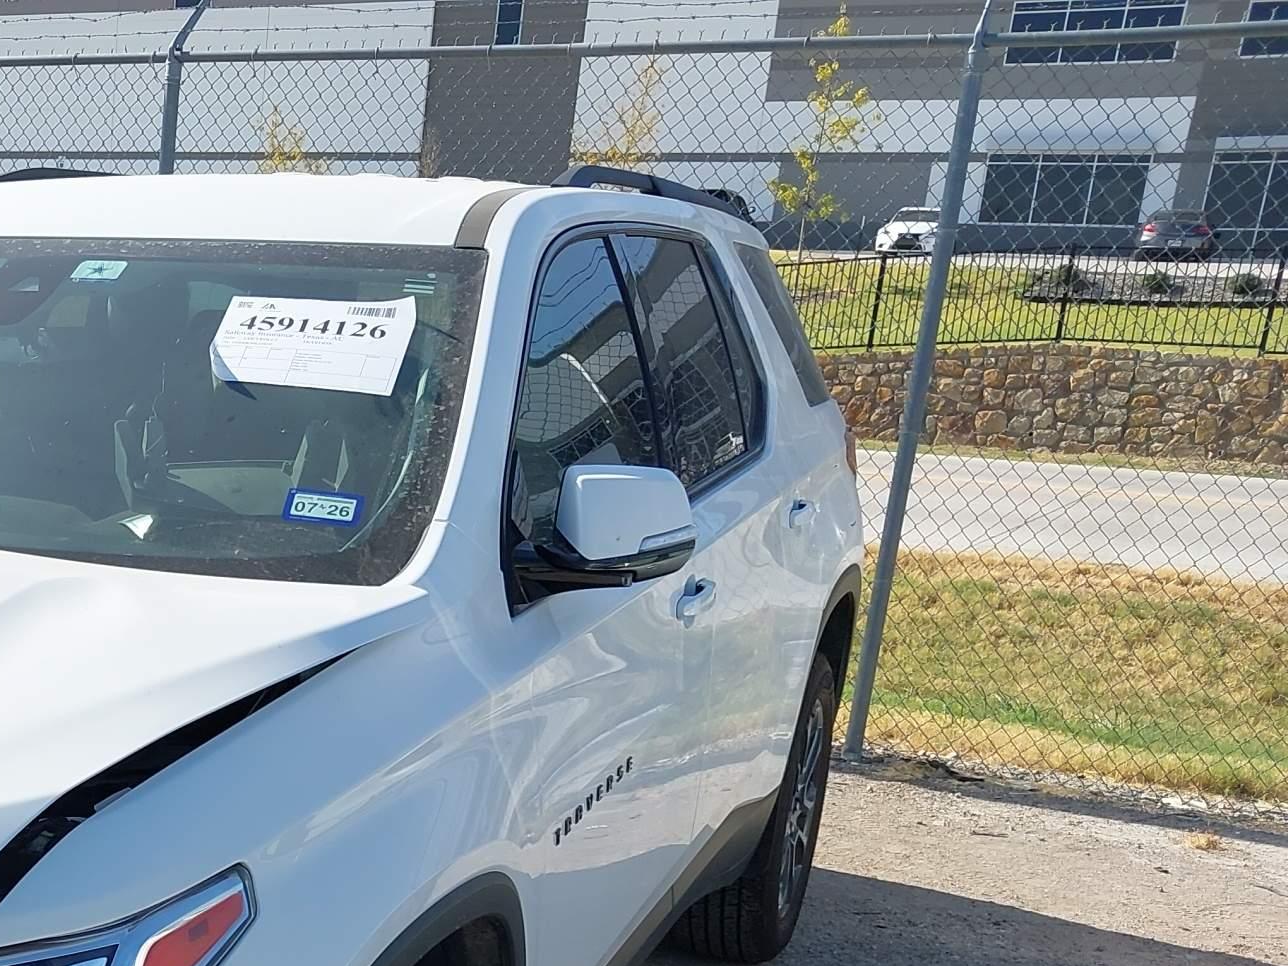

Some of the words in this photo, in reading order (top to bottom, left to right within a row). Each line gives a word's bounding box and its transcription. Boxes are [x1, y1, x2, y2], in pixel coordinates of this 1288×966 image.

[239, 315, 389, 340] 45914126
[294, 501, 318, 513] 07
[326, 504, 350, 517] 26
[554, 756, 633, 847] TRAVERSE
